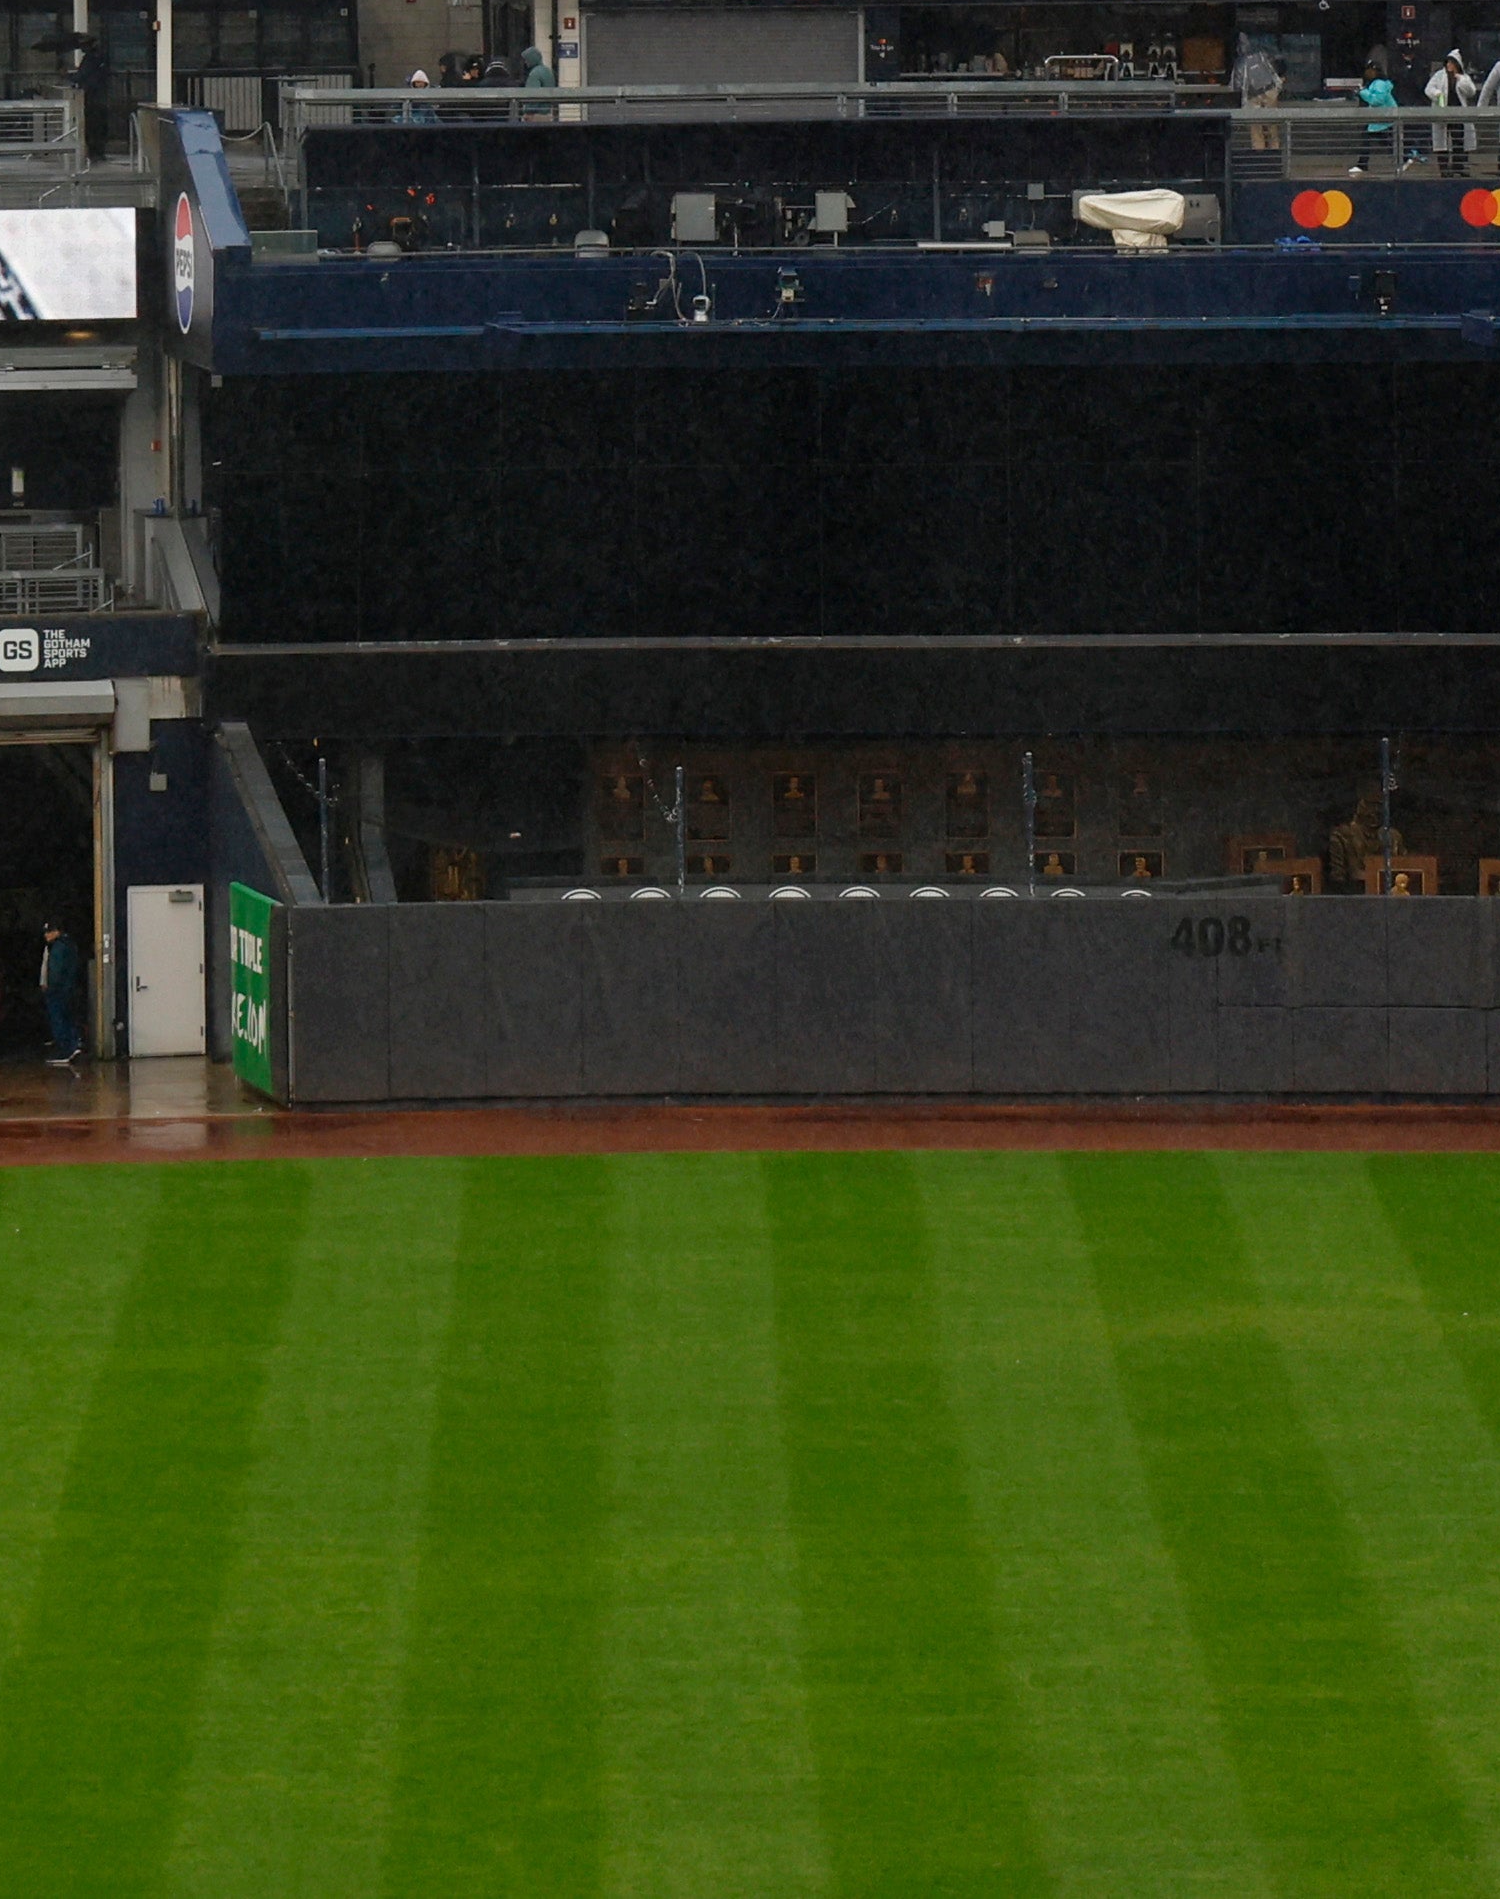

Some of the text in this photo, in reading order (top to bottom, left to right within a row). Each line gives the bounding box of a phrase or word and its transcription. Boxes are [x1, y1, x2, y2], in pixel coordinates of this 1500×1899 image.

[43, 629, 66, 640] THE
[43, 638, 91, 649] GOTHAM
[3, 640, 32, 660] GS
[43, 649, 87, 659] SPORTS
[43, 658, 67, 669] APP
[1171, 916, 1250, 957] 408
